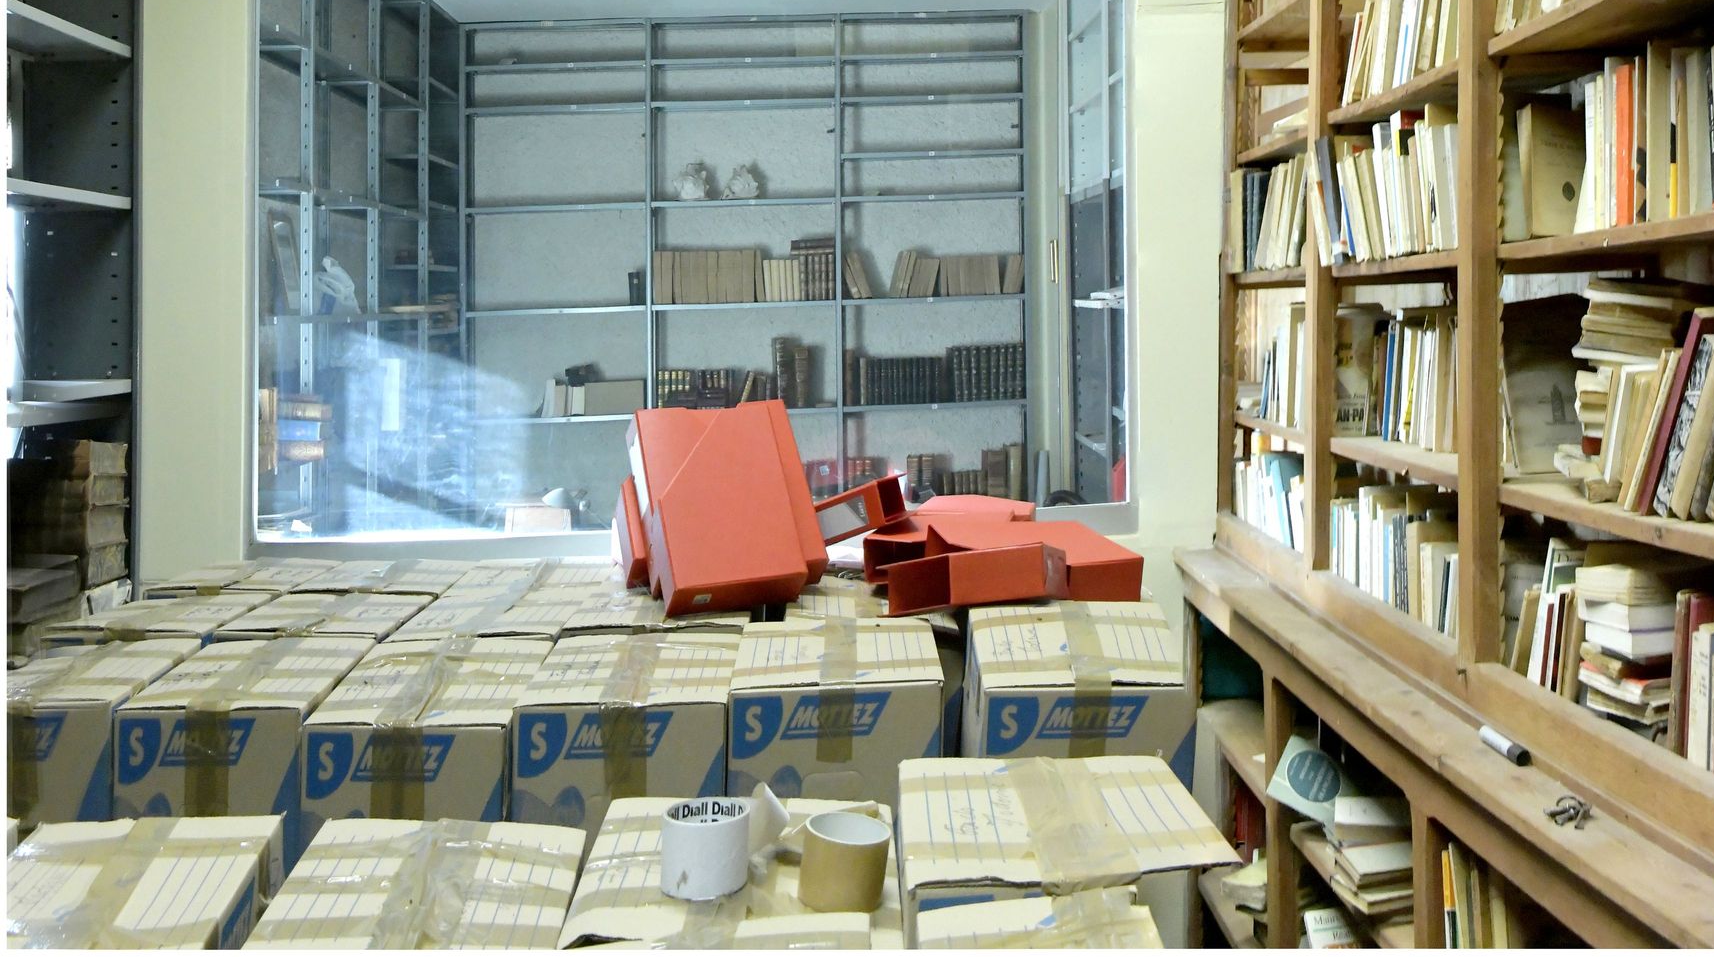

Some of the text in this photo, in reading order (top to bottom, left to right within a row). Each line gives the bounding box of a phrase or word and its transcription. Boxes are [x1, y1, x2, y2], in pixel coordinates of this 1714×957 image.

[744, 705, 763, 742] S
[999, 704, 1019, 740] S
[1045, 705, 1137, 729] MOTTEZ
[128, 726, 145, 766] S
[529, 722, 548, 761] S
[317, 741, 335, 781] S
[682, 801, 709, 818] Diall
[711, 801, 736, 818] Diall
